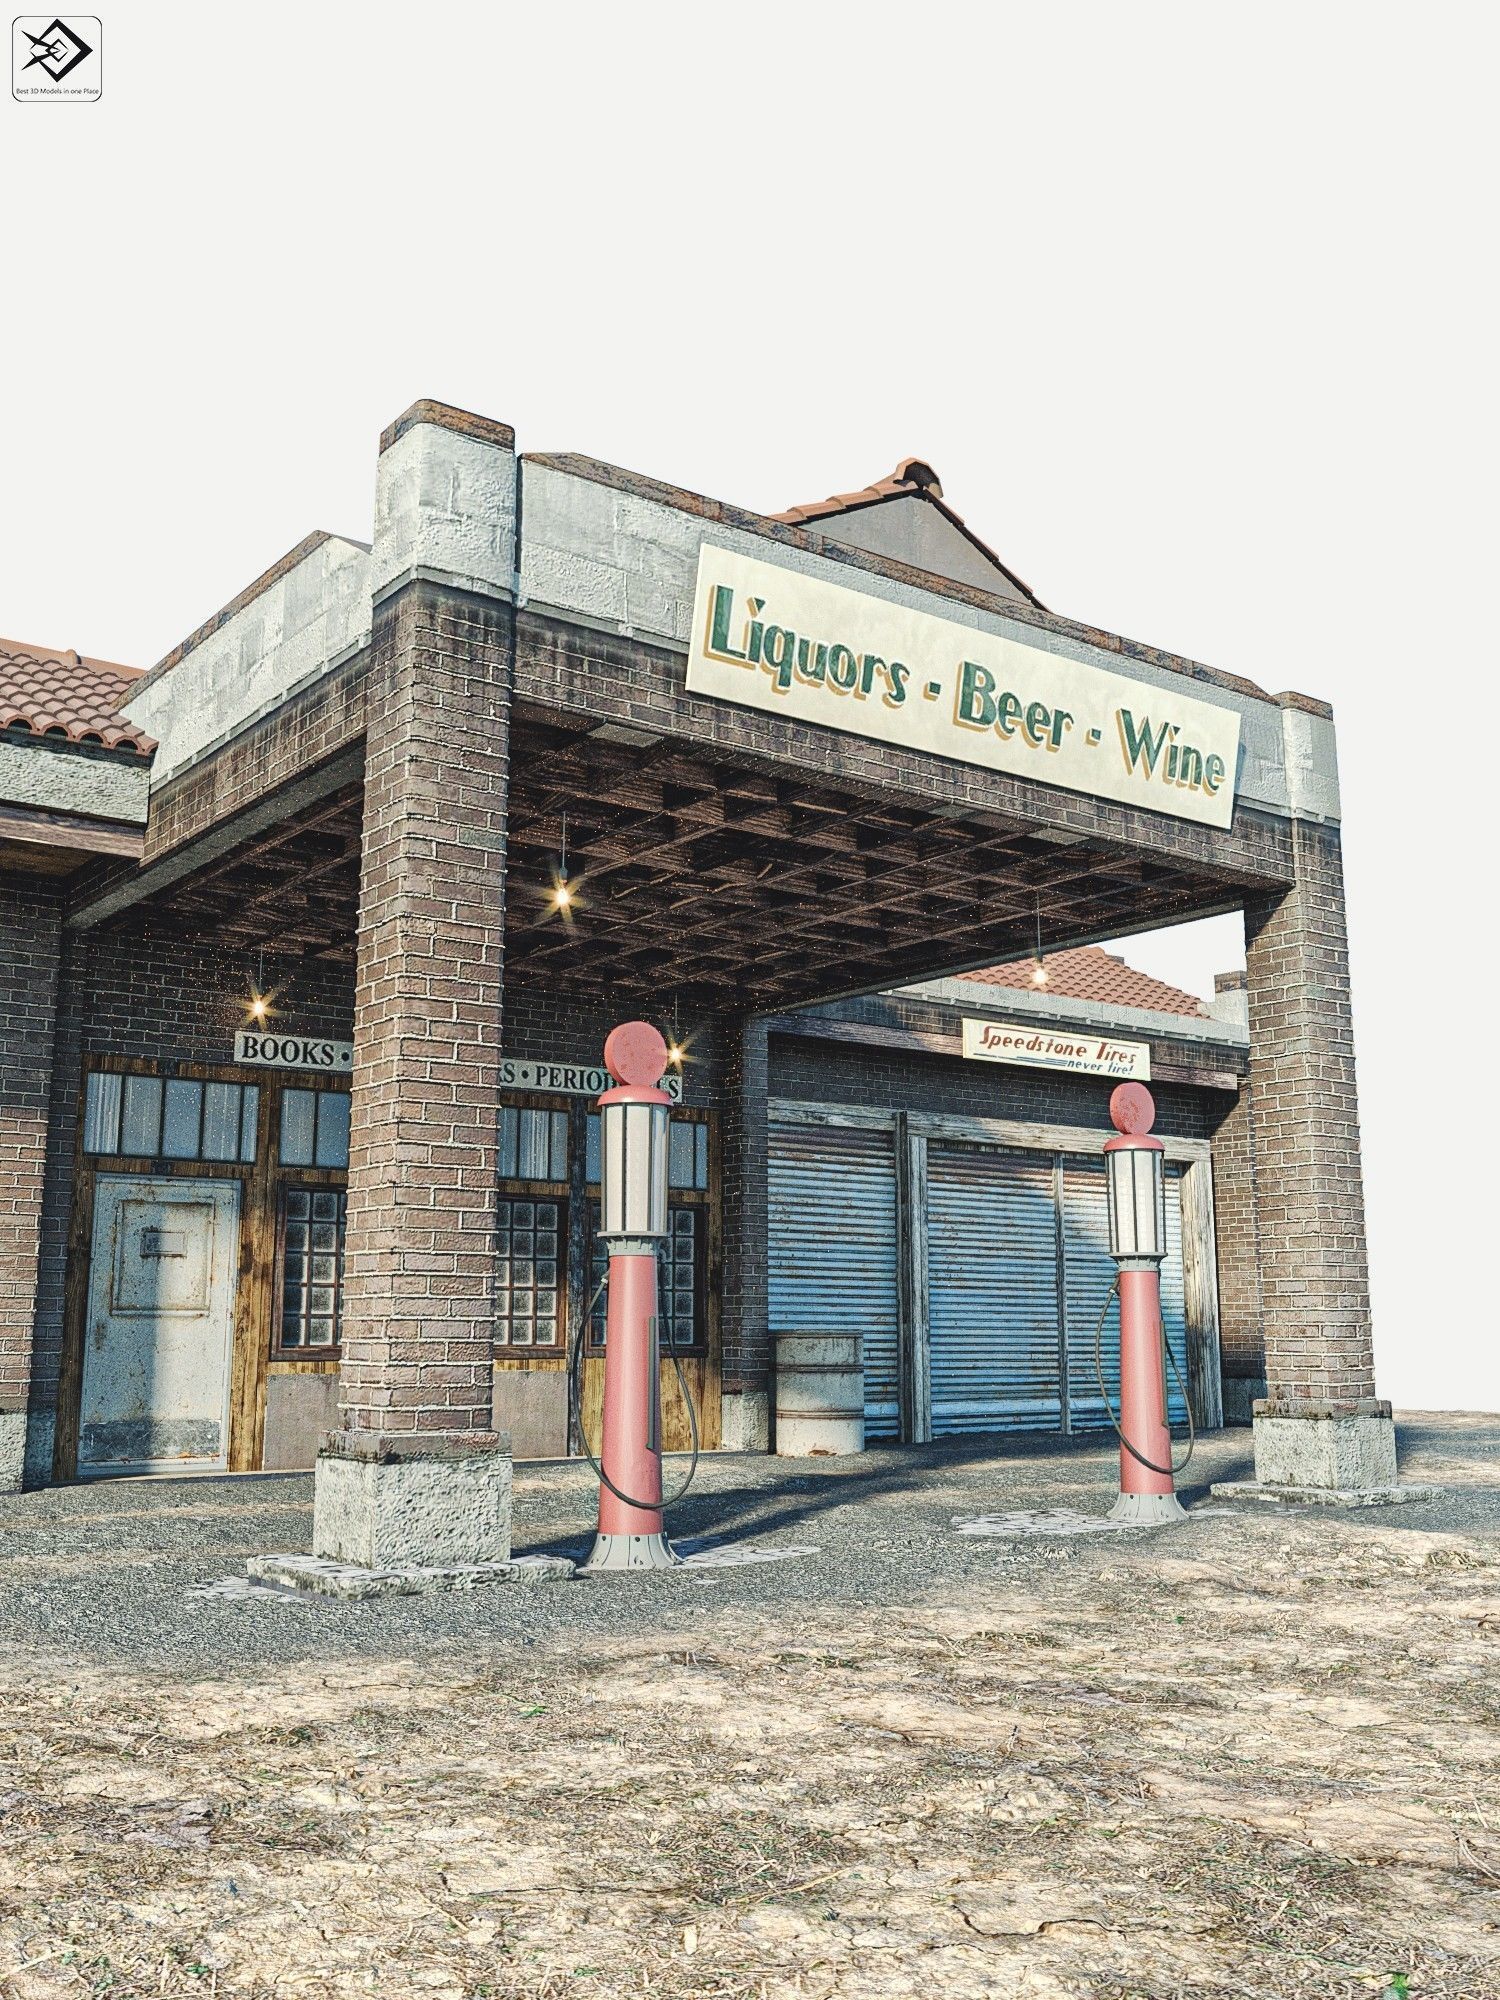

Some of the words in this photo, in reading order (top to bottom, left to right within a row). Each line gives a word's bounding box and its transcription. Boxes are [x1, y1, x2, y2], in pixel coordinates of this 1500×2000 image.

[704, 584, 910, 708] Liquors
[954, 660, 1074, 752] Beer
[1116, 708, 1227, 796] Wine
[242, 1036, 334, 1066] BOOKS
[979, 1025, 1088, 1058] Speedstone
[1096, 1041, 1137, 1064] Tires
[1067, 1060, 1103, 1072] never
[1107, 1062, 1134, 1075] tire!
